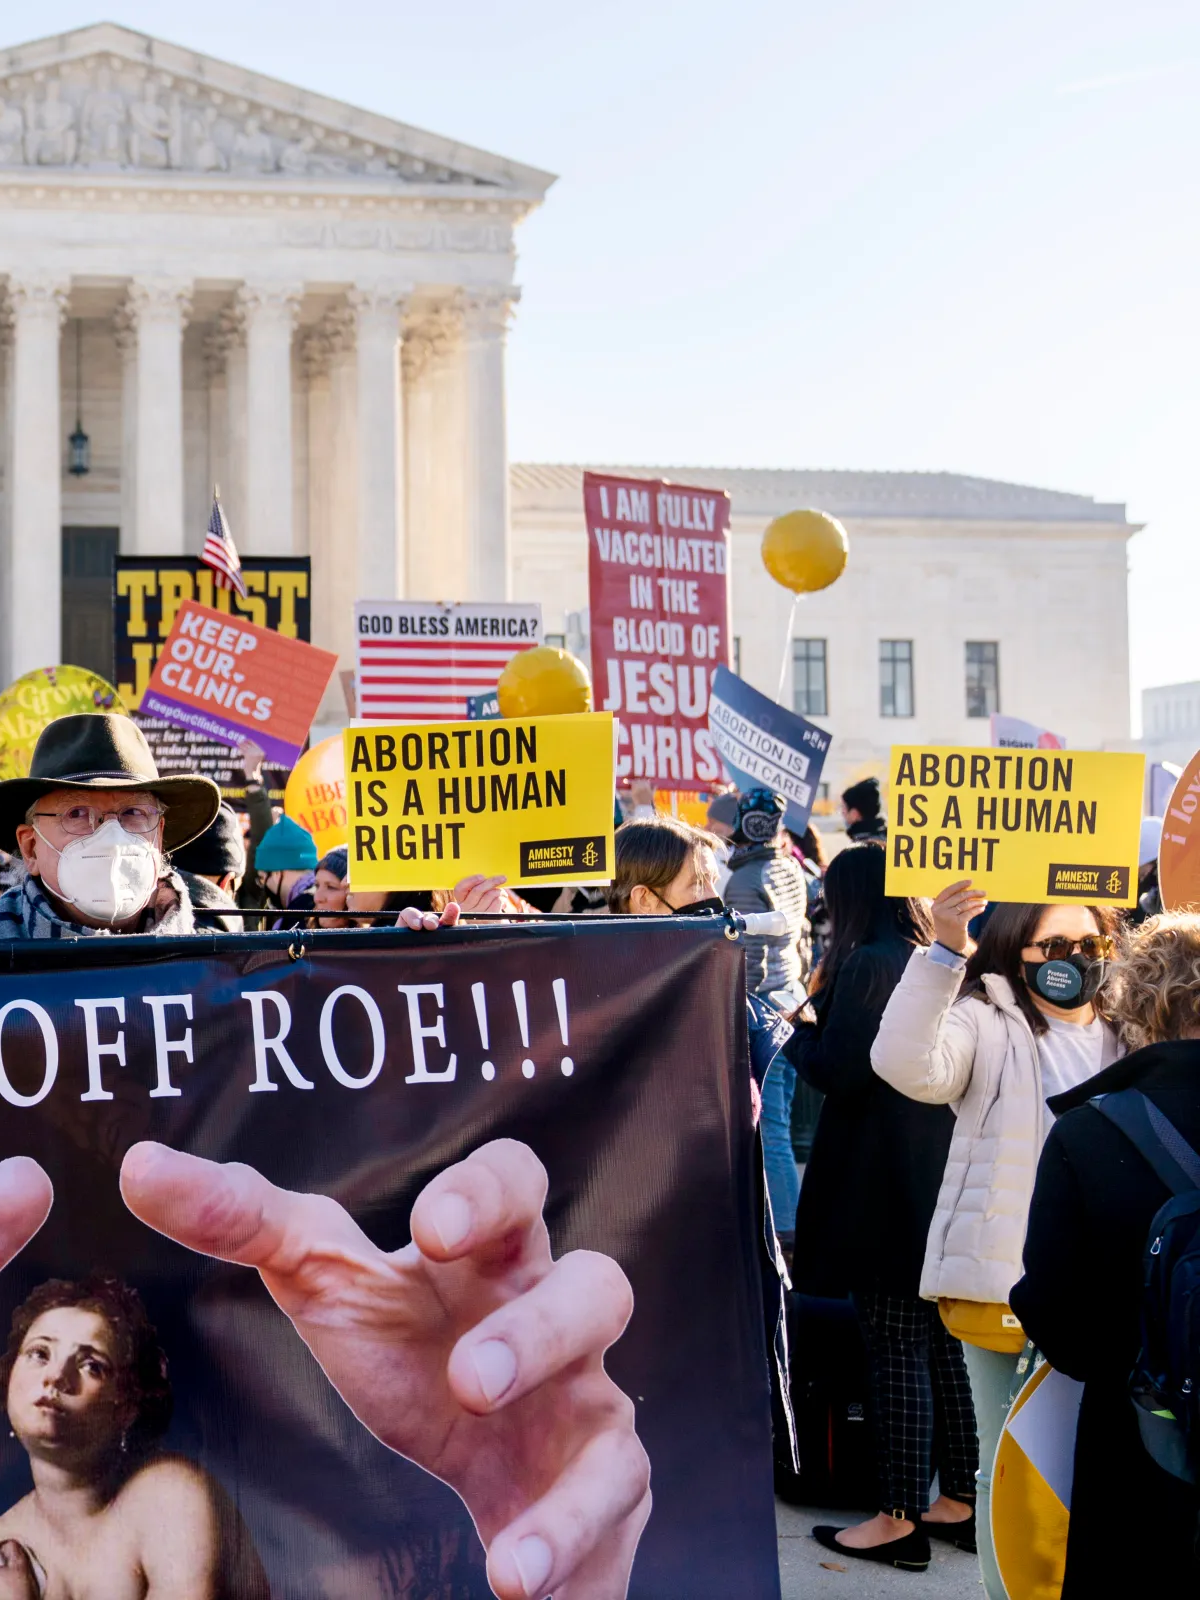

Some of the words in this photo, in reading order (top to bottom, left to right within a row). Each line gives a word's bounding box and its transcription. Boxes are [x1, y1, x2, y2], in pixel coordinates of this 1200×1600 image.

[600, 485, 610, 519] I
[616, 487, 650, 523] AM
[656, 493, 716, 532] FULLY
[594, 528, 727, 575] VACCINATED
[630, 574, 653, 610] IN
[657, 577, 700, 615] THE
[179, 611, 258, 656] KEEP
[359, 615, 392, 634] GOD
[399, 616, 449, 635] BLESS
[455, 617, 538, 637] AMERICA?
[613, 617, 685, 657] BLOOD
[691, 624, 720, 659] OF
[171, 638, 235, 680] OUR
[161, 662, 274, 722] CLINICS
[147, 697, 247, 745] KeepOurClinics.org
[713, 703, 785, 764] ABORTION
[786, 752, 804, 774] IS
[350, 725, 538, 773] ABORTION
[354, 780, 388, 817] IS
[402, 779, 425, 816] A
[439, 769, 566, 815] HUMAN
[761, 765, 806, 798] CARE
[895, 753, 1073, 792] ABORTION
[896, 794, 928, 827] IS
[941, 796, 962, 829] A
[976, 797, 1097, 835] HUMAN
[356, 822, 466, 862] RIGHT
[528, 845, 574, 862] AMNESTY
[893, 835, 1000, 872] RIGHT
[528, 859, 574, 870] INTERNATIONAL
[1055, 870, 1100, 884] AMNESTY
[1054, 881, 1099, 892] INTERNATIONAL
[241, 978, 575, 1092] ROE!!!
